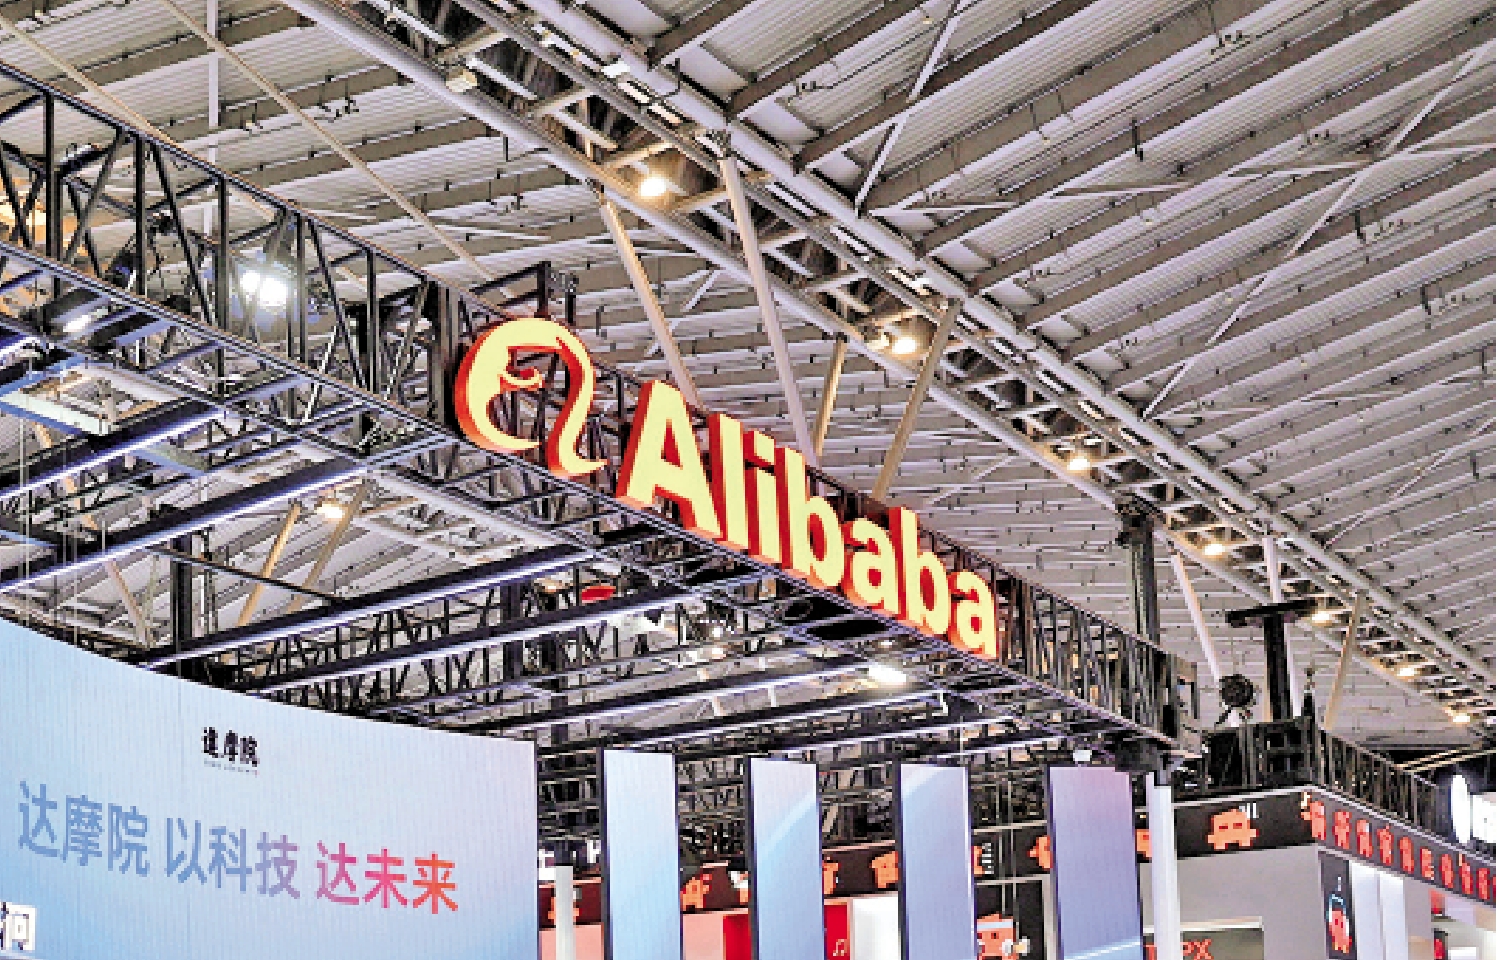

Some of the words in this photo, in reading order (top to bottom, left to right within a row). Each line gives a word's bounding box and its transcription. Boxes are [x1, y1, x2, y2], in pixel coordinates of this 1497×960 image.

[618, 379, 998, 660] Alibaba
[18, 780, 150, 878] 达摩院
[163, 818, 301, 900] 以科技
[316, 840, 459, 914] 达未来
